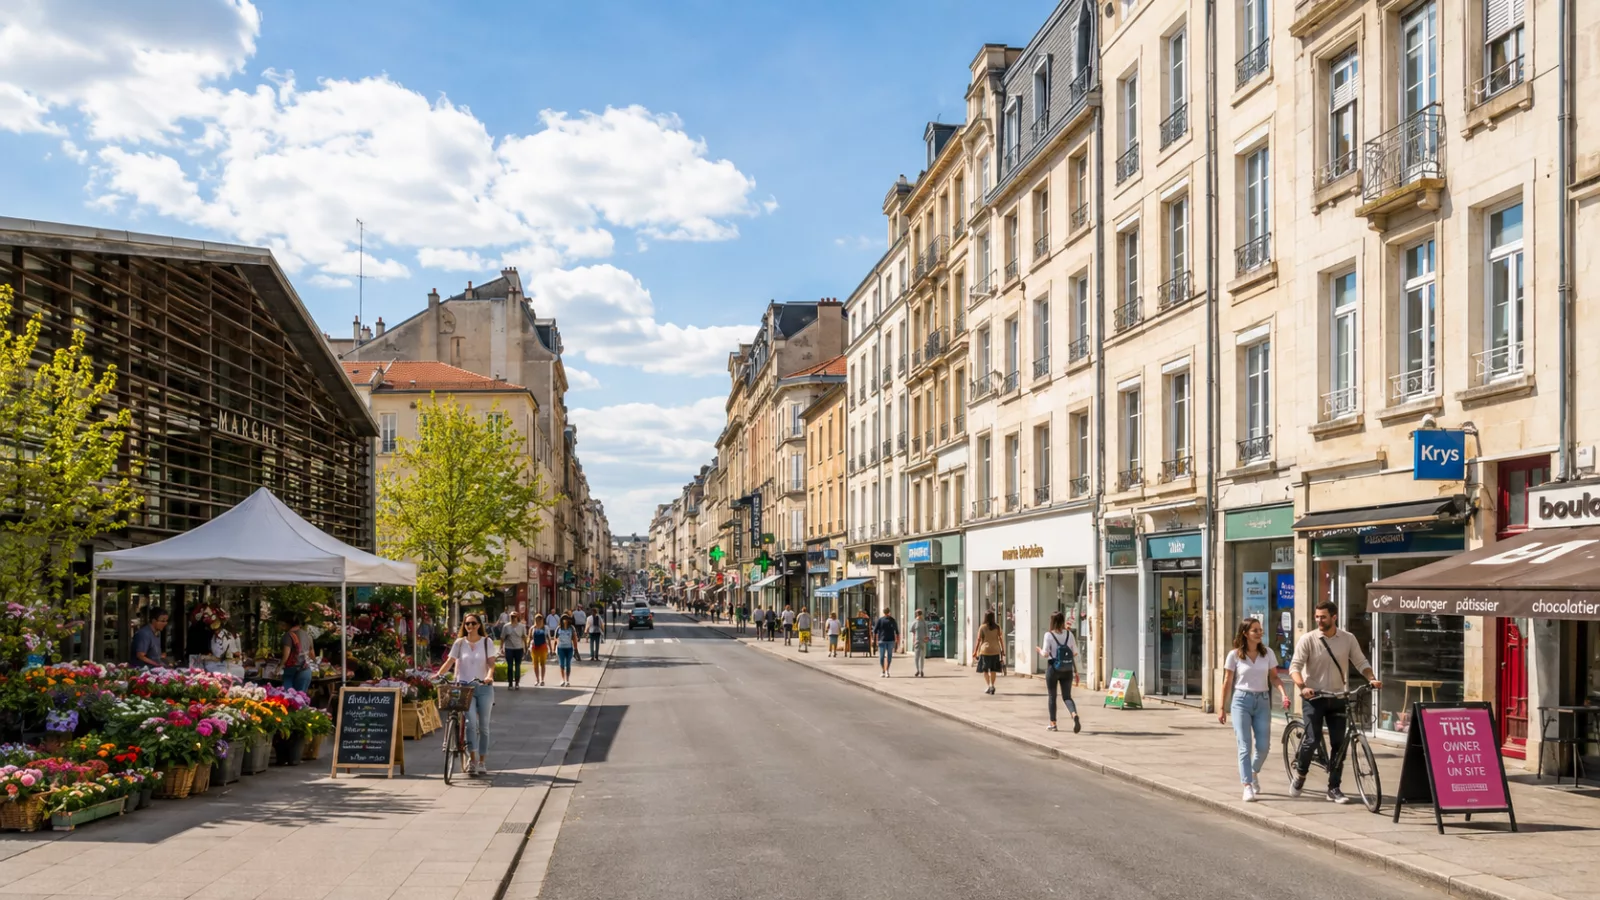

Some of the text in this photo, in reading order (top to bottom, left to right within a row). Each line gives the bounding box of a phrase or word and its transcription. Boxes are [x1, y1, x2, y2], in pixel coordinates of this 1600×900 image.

[1421, 444, 1460, 466] Krys
[1400, 596, 1447, 612] boulanger
[1456, 597, 1499, 613] pâtissier
[1532, 598, 1600, 614] chocolatier
[1439, 721, 1476, 736] THIS
[1443, 741, 1481, 752] OWNER
[1446, 753, 1481, 764] A FAIT
[1447, 766, 1486, 776] UN SITE
